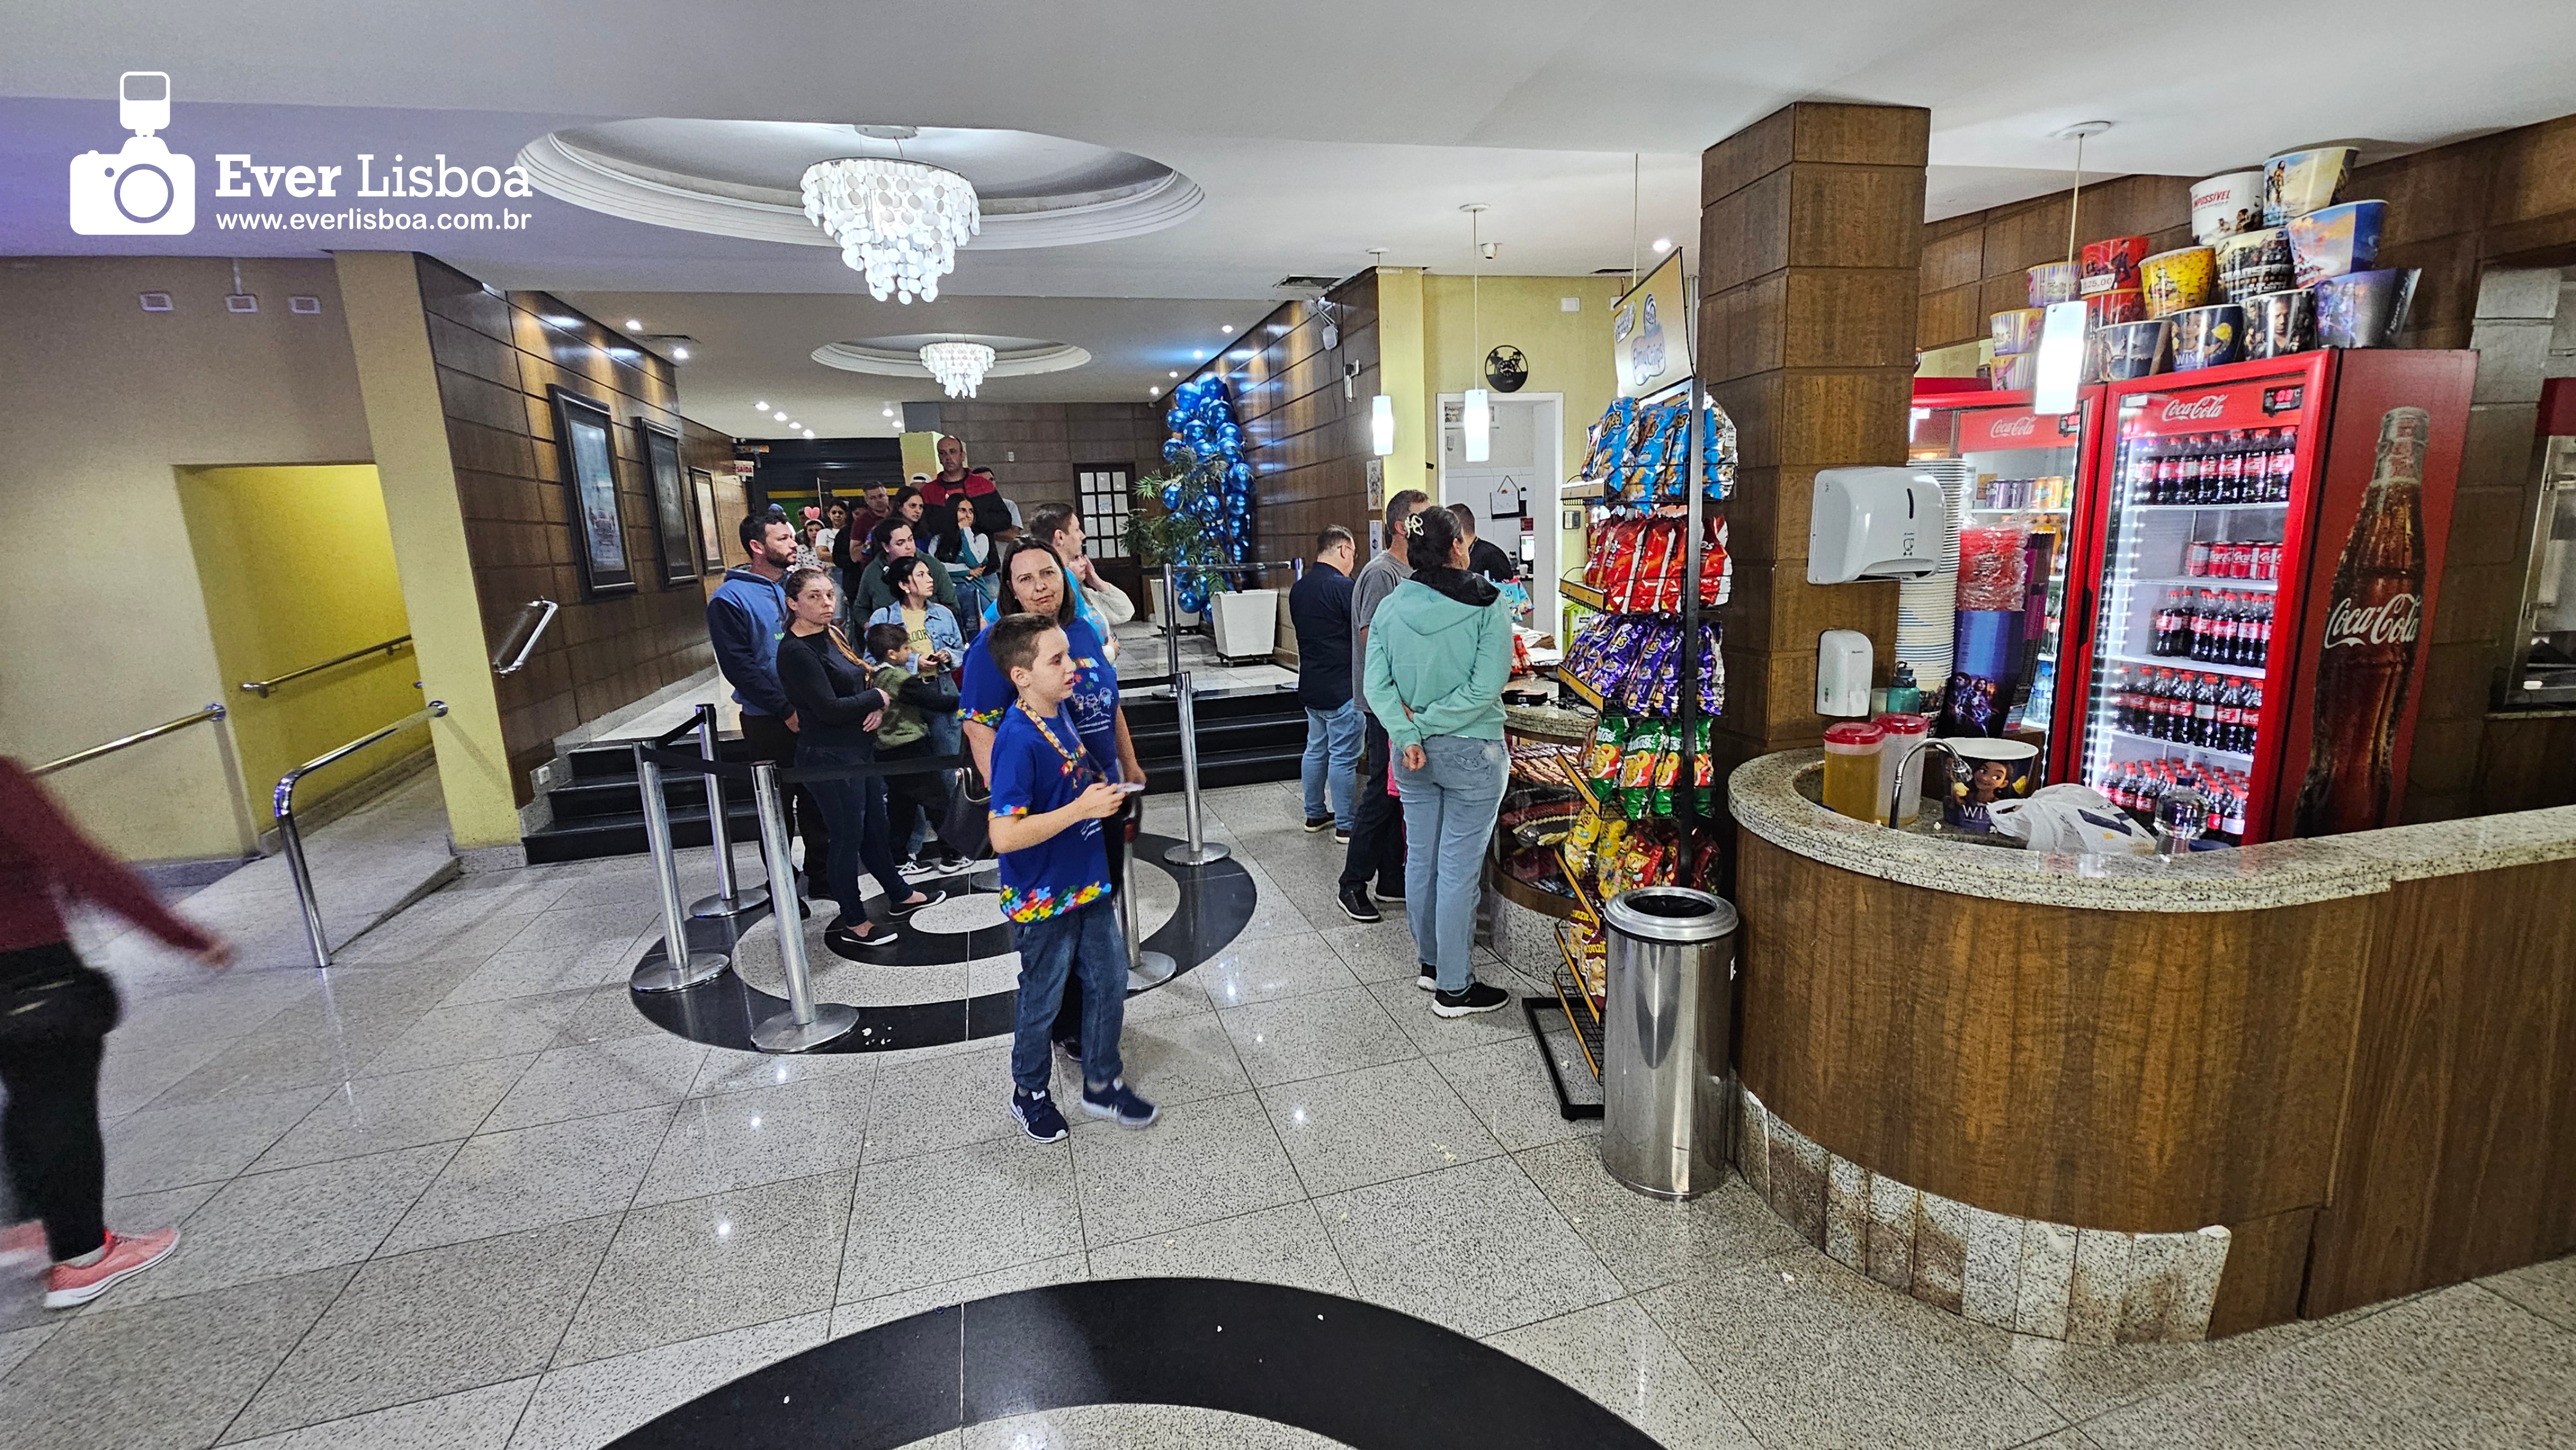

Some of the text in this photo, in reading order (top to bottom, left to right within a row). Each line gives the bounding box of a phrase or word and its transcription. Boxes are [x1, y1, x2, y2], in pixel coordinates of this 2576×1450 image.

[2162, 394, 2229, 422] Coca-Cola
[2275, 389, 2294, 402] 03
[1990, 416, 2038, 438] Coca-Cola
[2324, 593, 2422, 649] Coca-Cola
